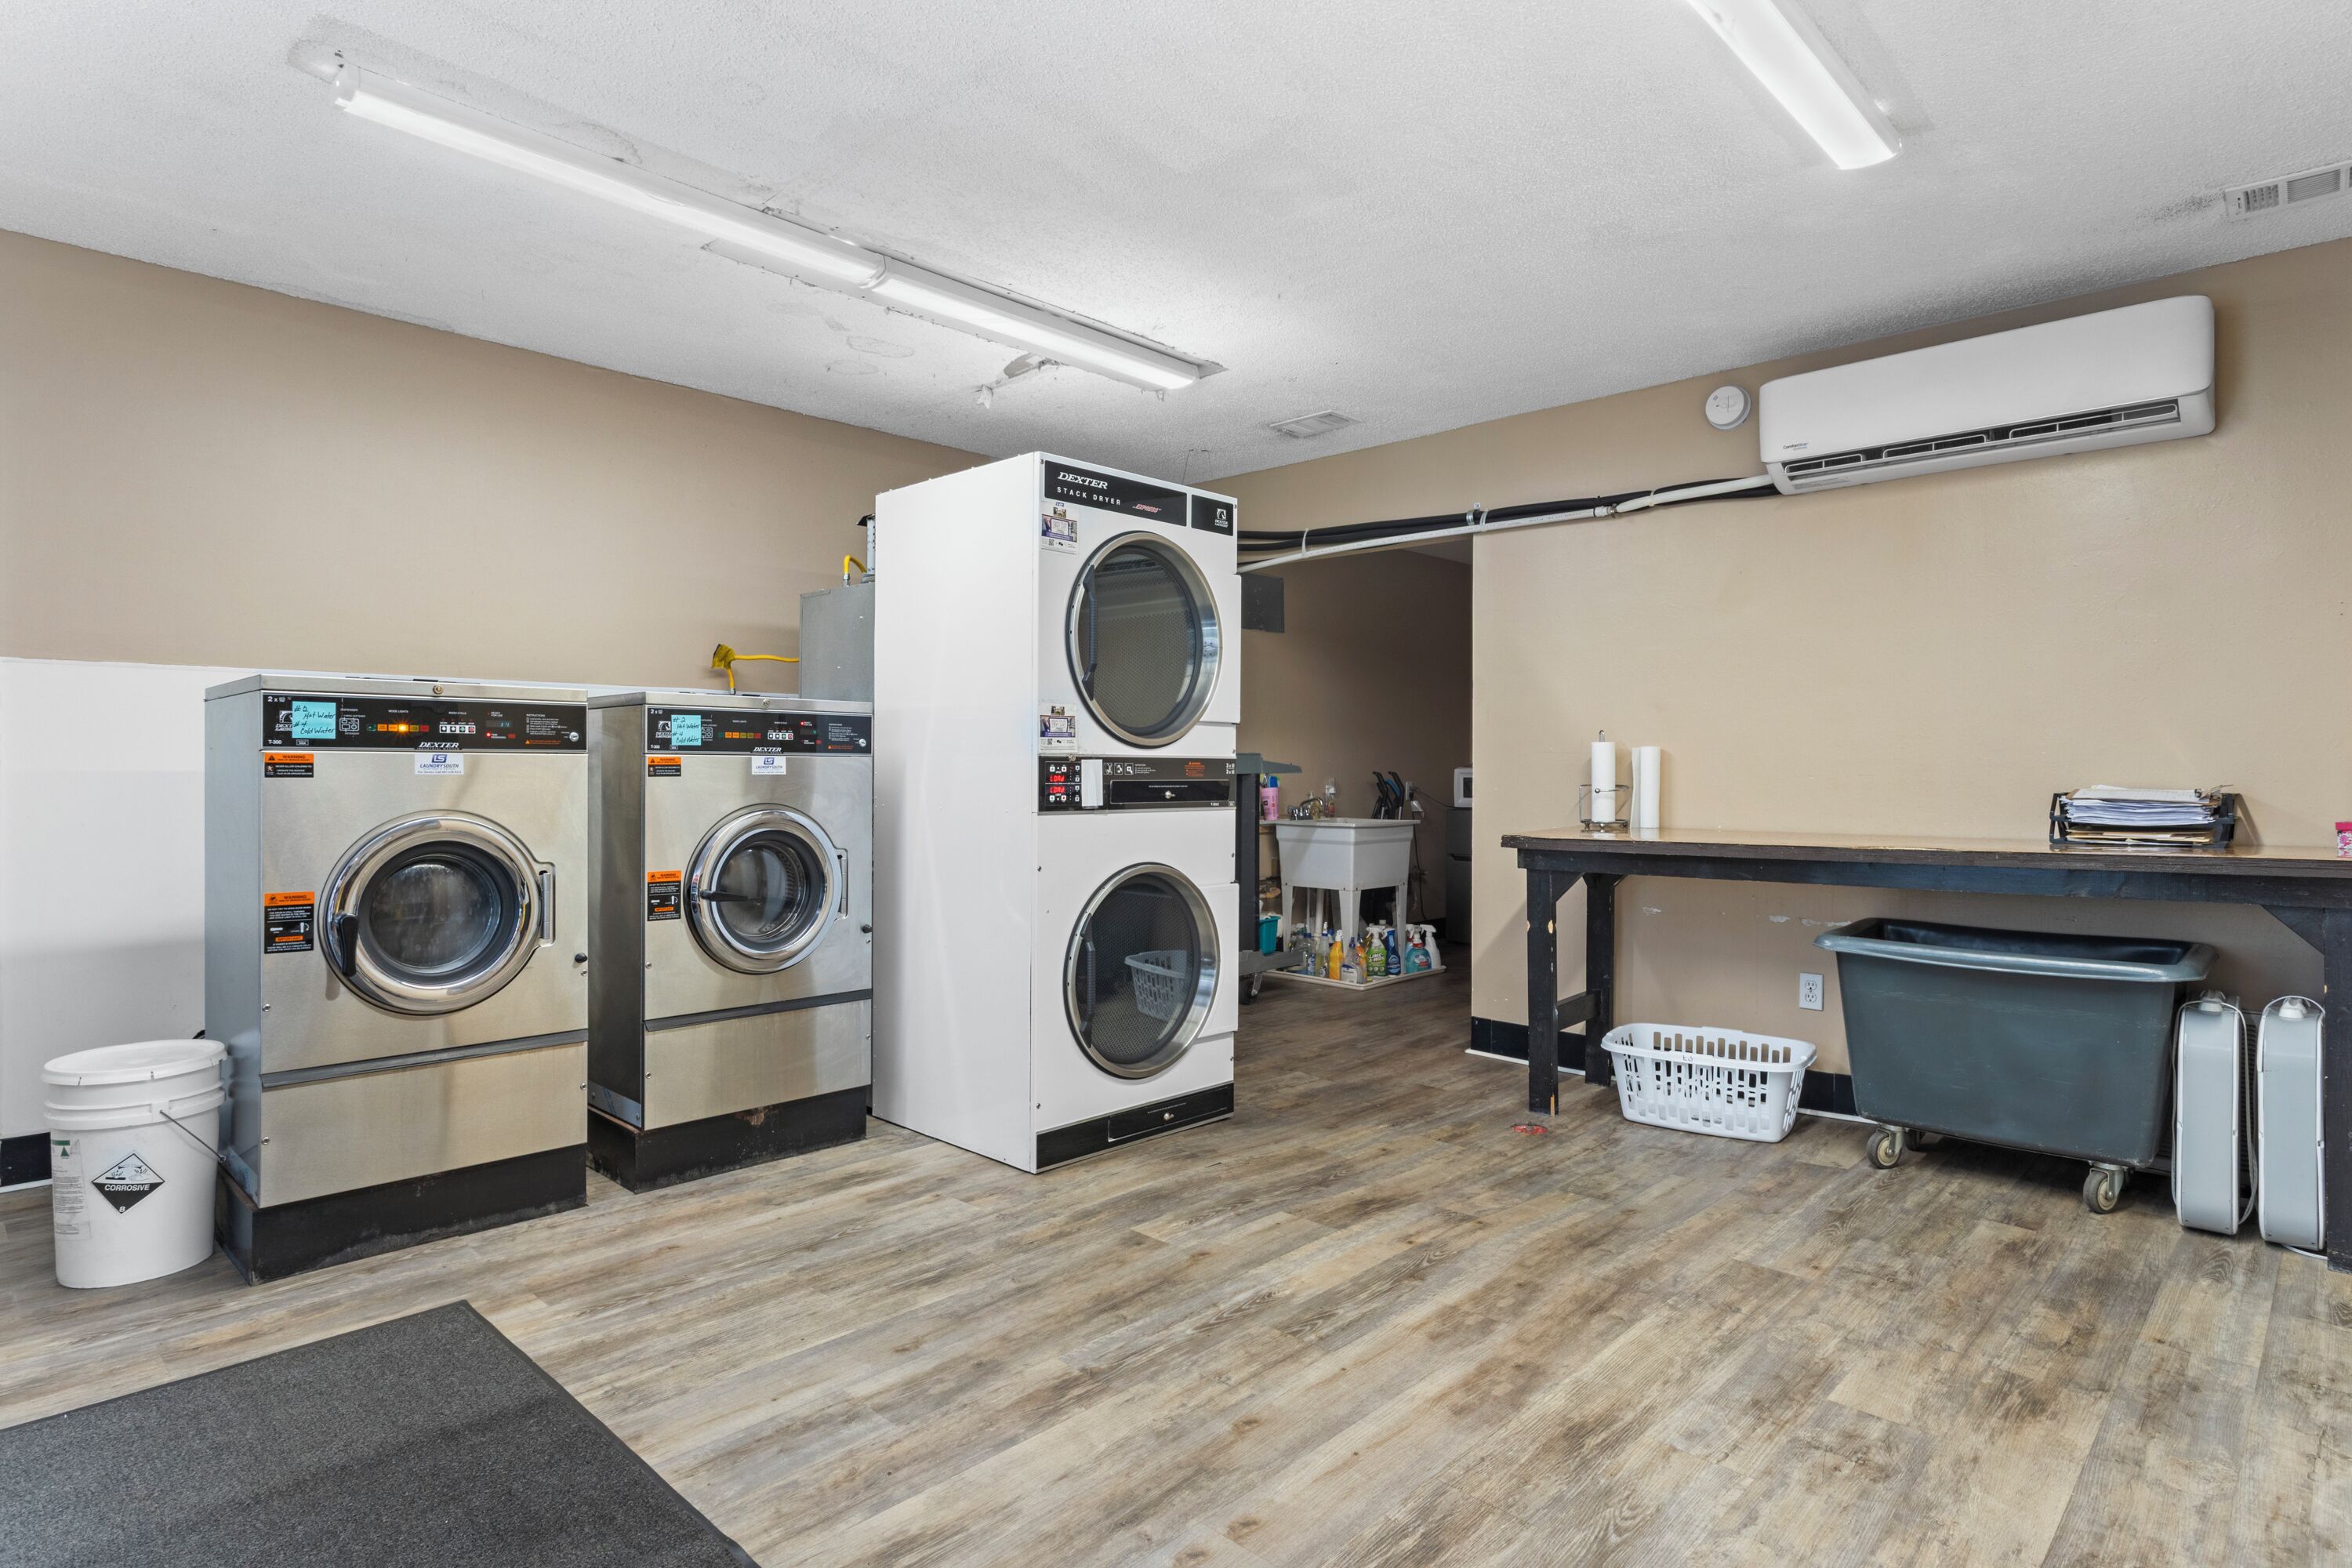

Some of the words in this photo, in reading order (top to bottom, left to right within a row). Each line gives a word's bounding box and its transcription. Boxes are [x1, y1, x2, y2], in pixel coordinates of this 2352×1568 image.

[1057, 472, 1108, 489] DEXTER
[1057, 486, 1087, 498] STACK
[1093, 494, 1121, 505] DRYER
[303, 711, 316, 720] Hot
